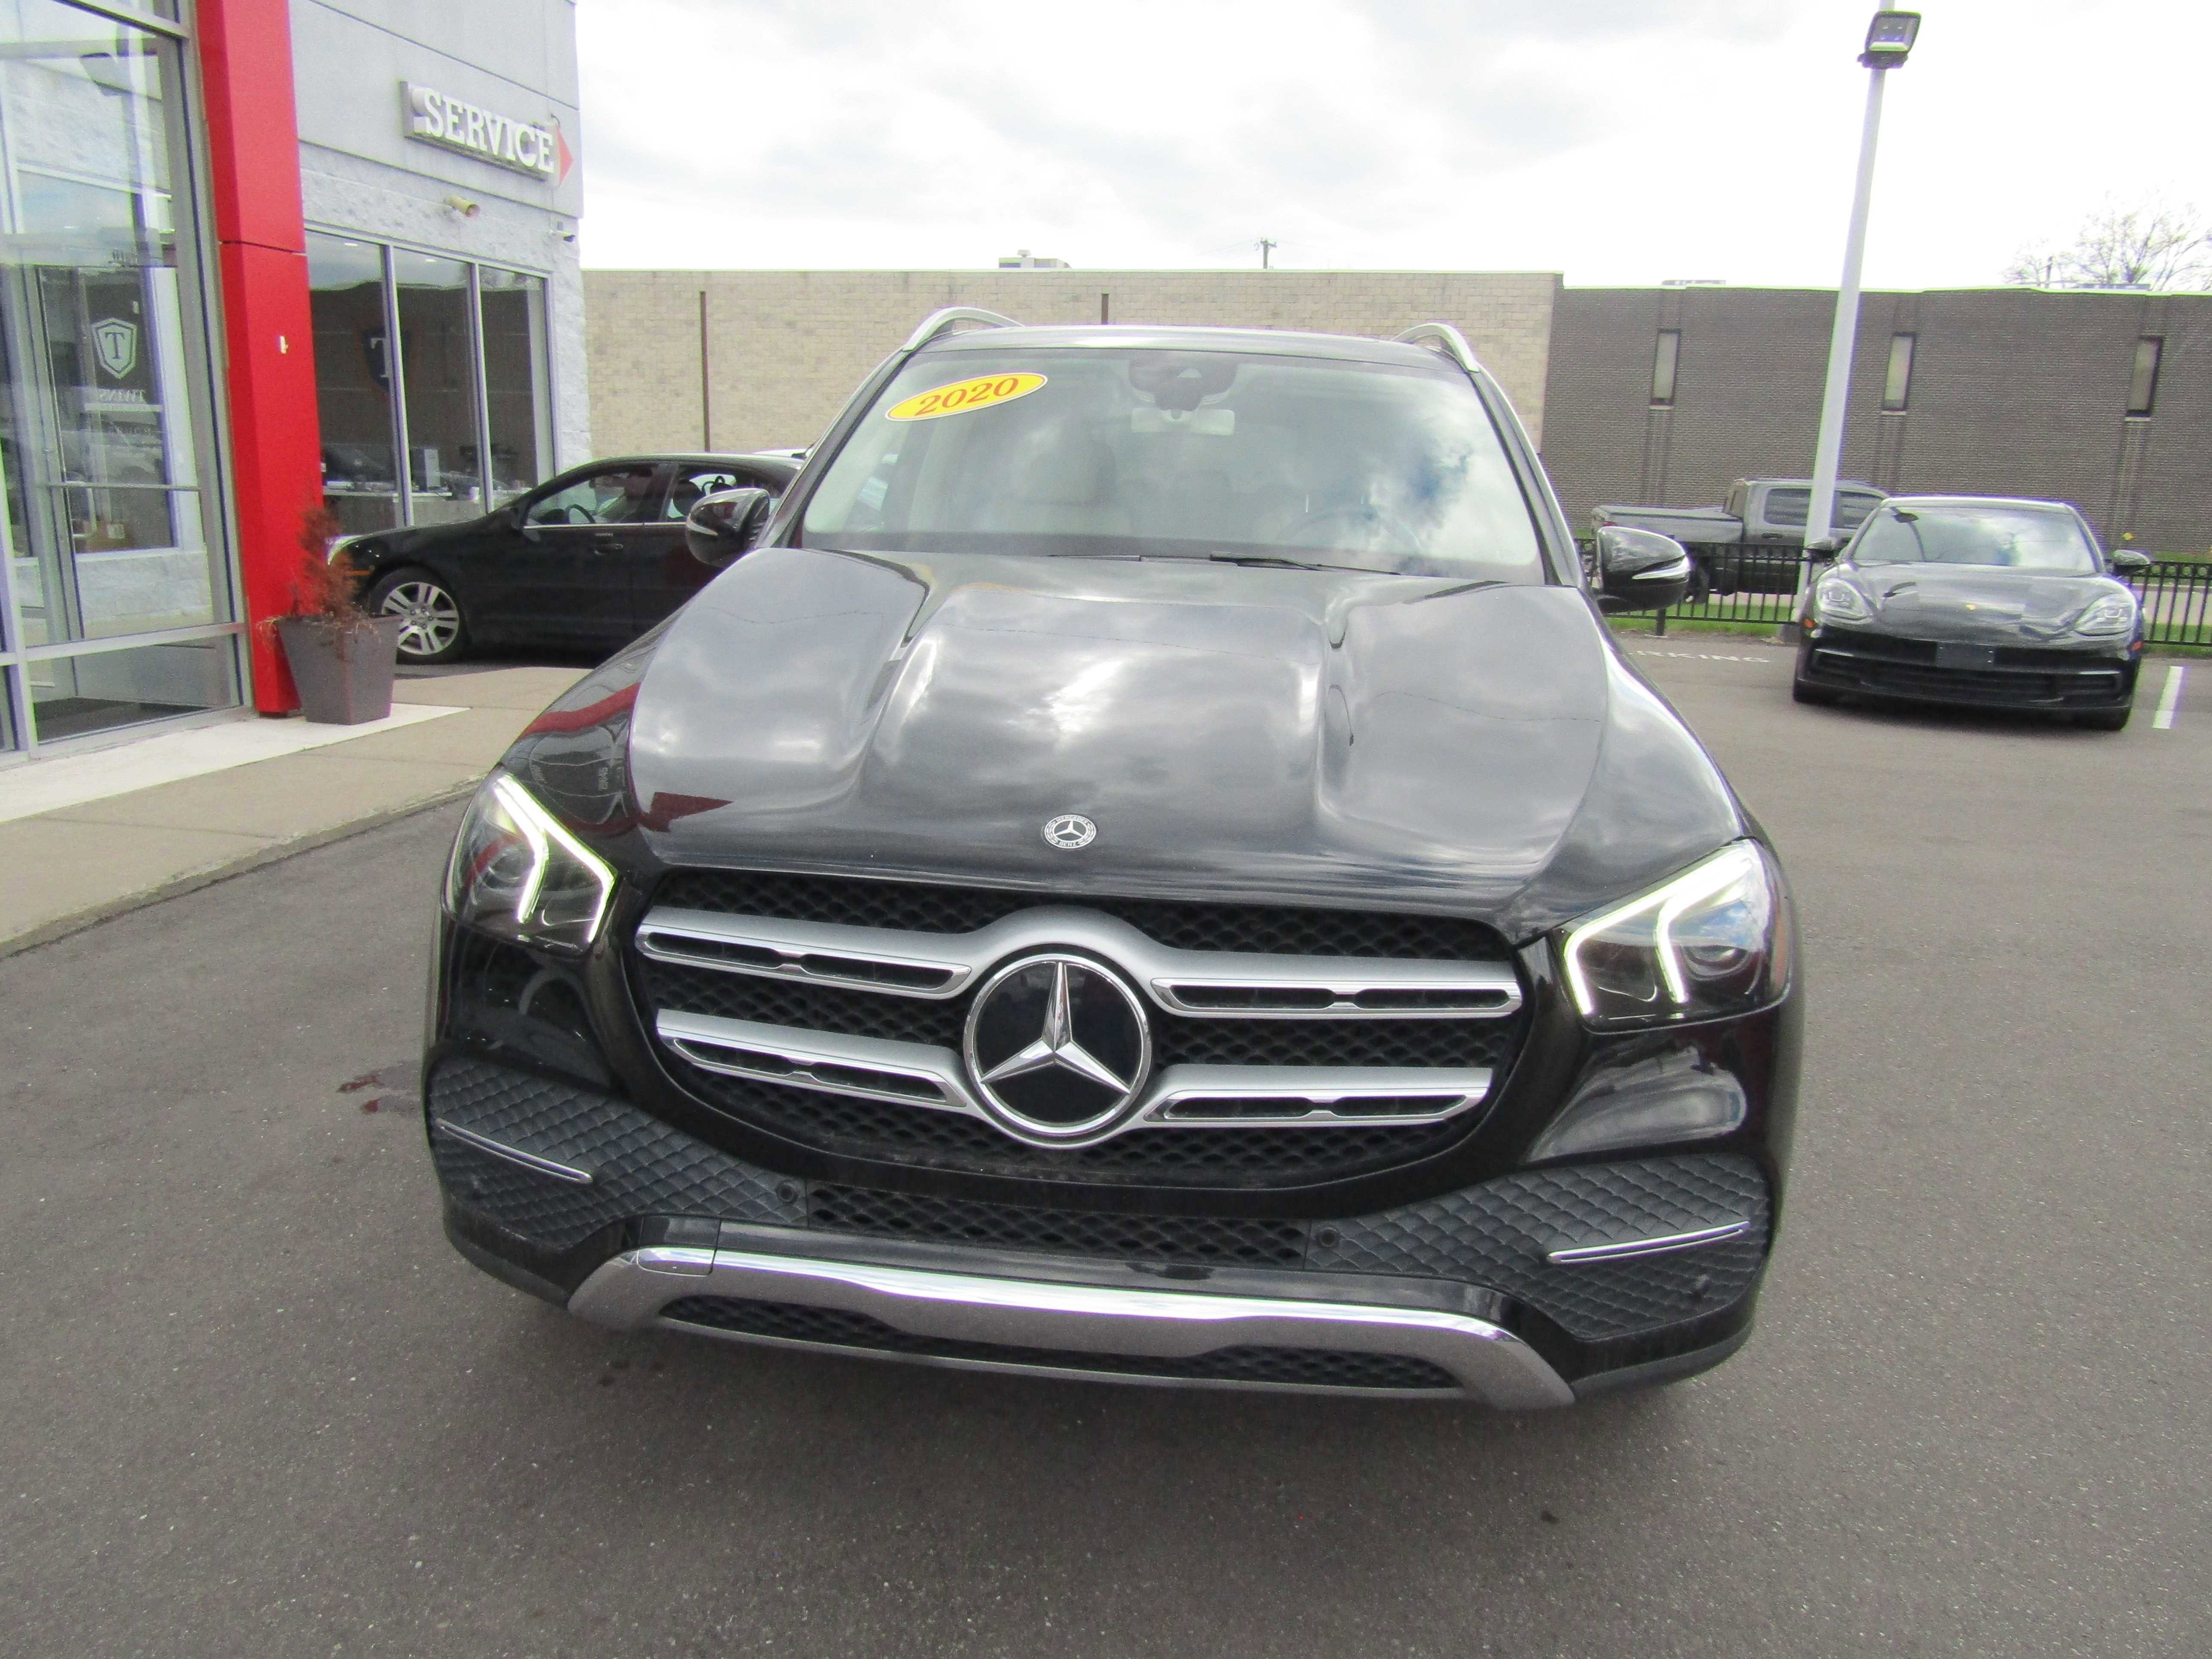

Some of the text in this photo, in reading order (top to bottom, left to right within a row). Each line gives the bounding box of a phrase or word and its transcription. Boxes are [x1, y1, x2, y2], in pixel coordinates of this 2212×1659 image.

[424, 88, 554, 173] SERVICE
[104, 331, 125, 359] T
[914, 377, 1019, 416] 2020
